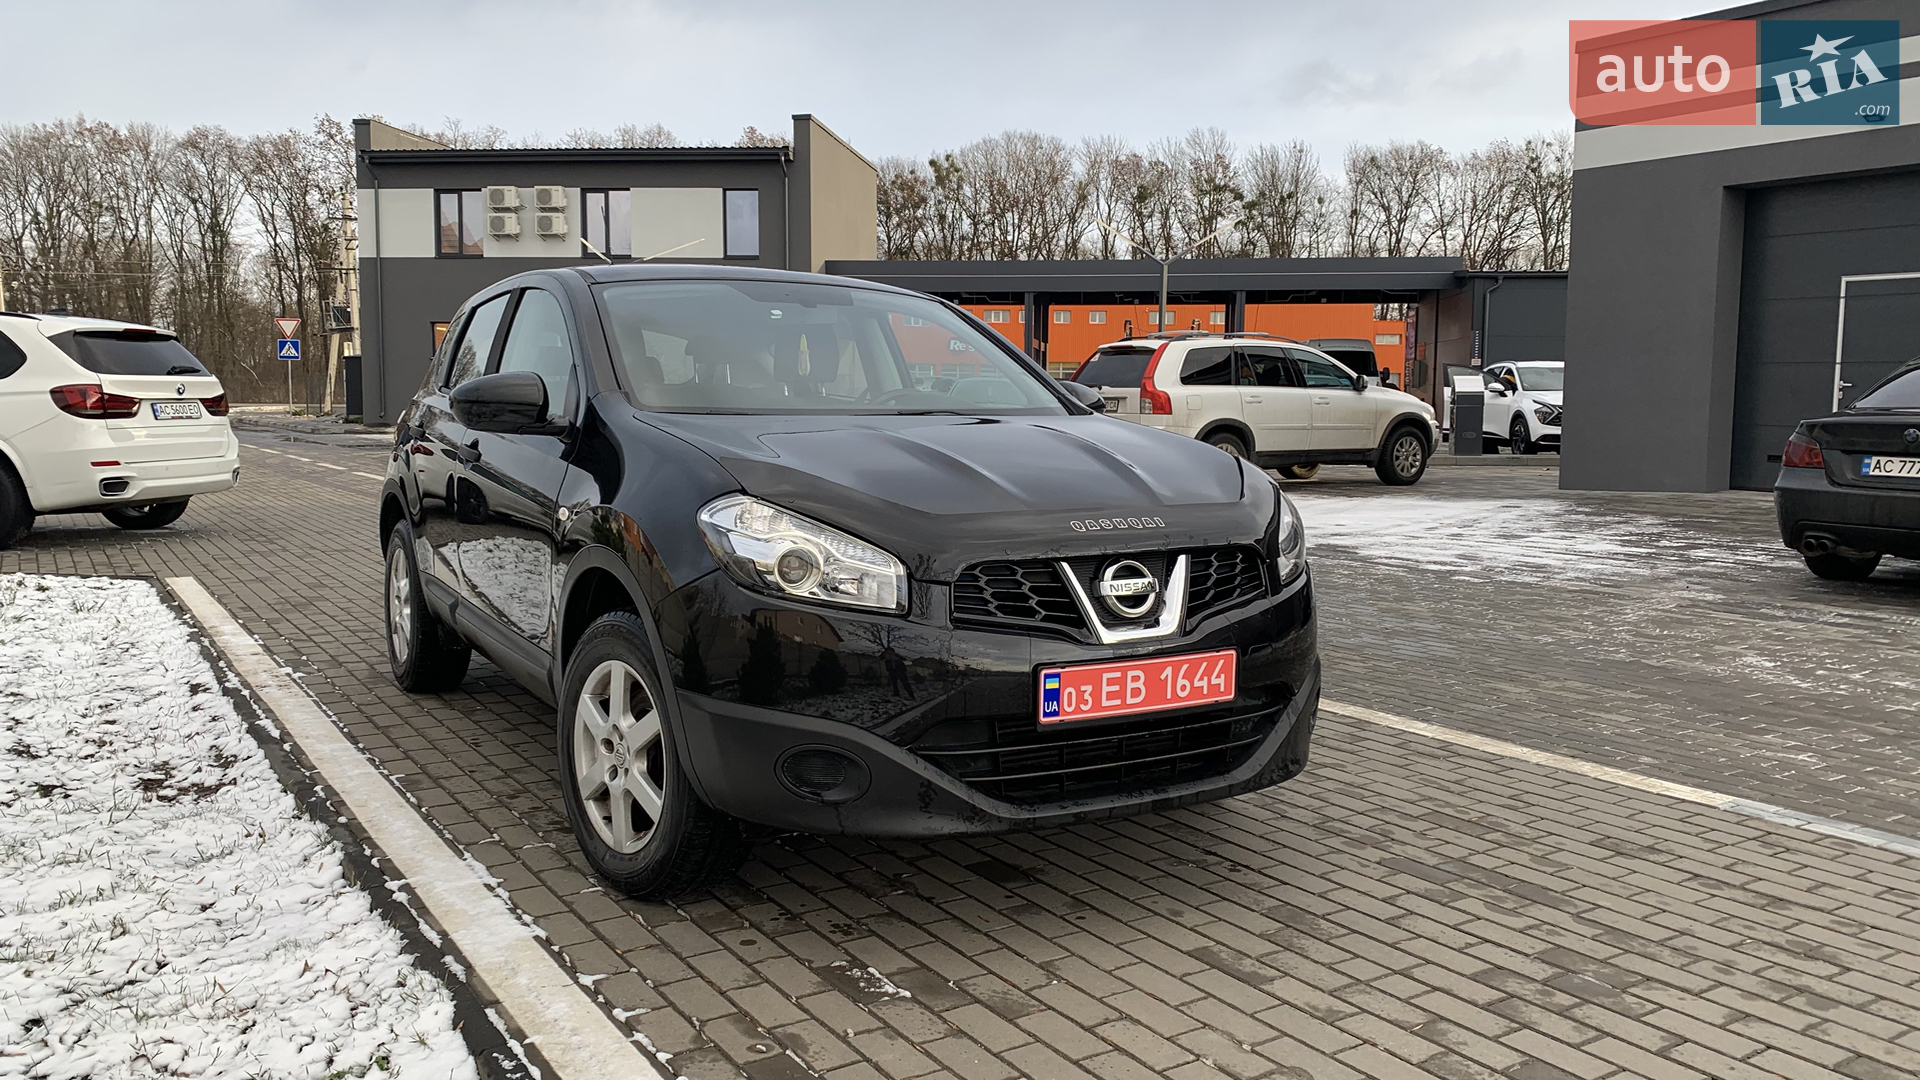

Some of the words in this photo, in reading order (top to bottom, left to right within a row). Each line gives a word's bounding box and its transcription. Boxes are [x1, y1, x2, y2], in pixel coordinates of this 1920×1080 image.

[160, 405, 170, 415] AC
[170, 404, 188, 414] 5600
[1872, 459, 1894, 473] AC
[1070, 516, 1166, 532] QASHQAI
[1109, 578, 1156, 593] NISSAN
[1044, 701, 1059, 713] UA
[1063, 684, 1093, 713] 03
[1101, 669, 1146, 707] EB
[1159, 659, 1226, 700] 1644
